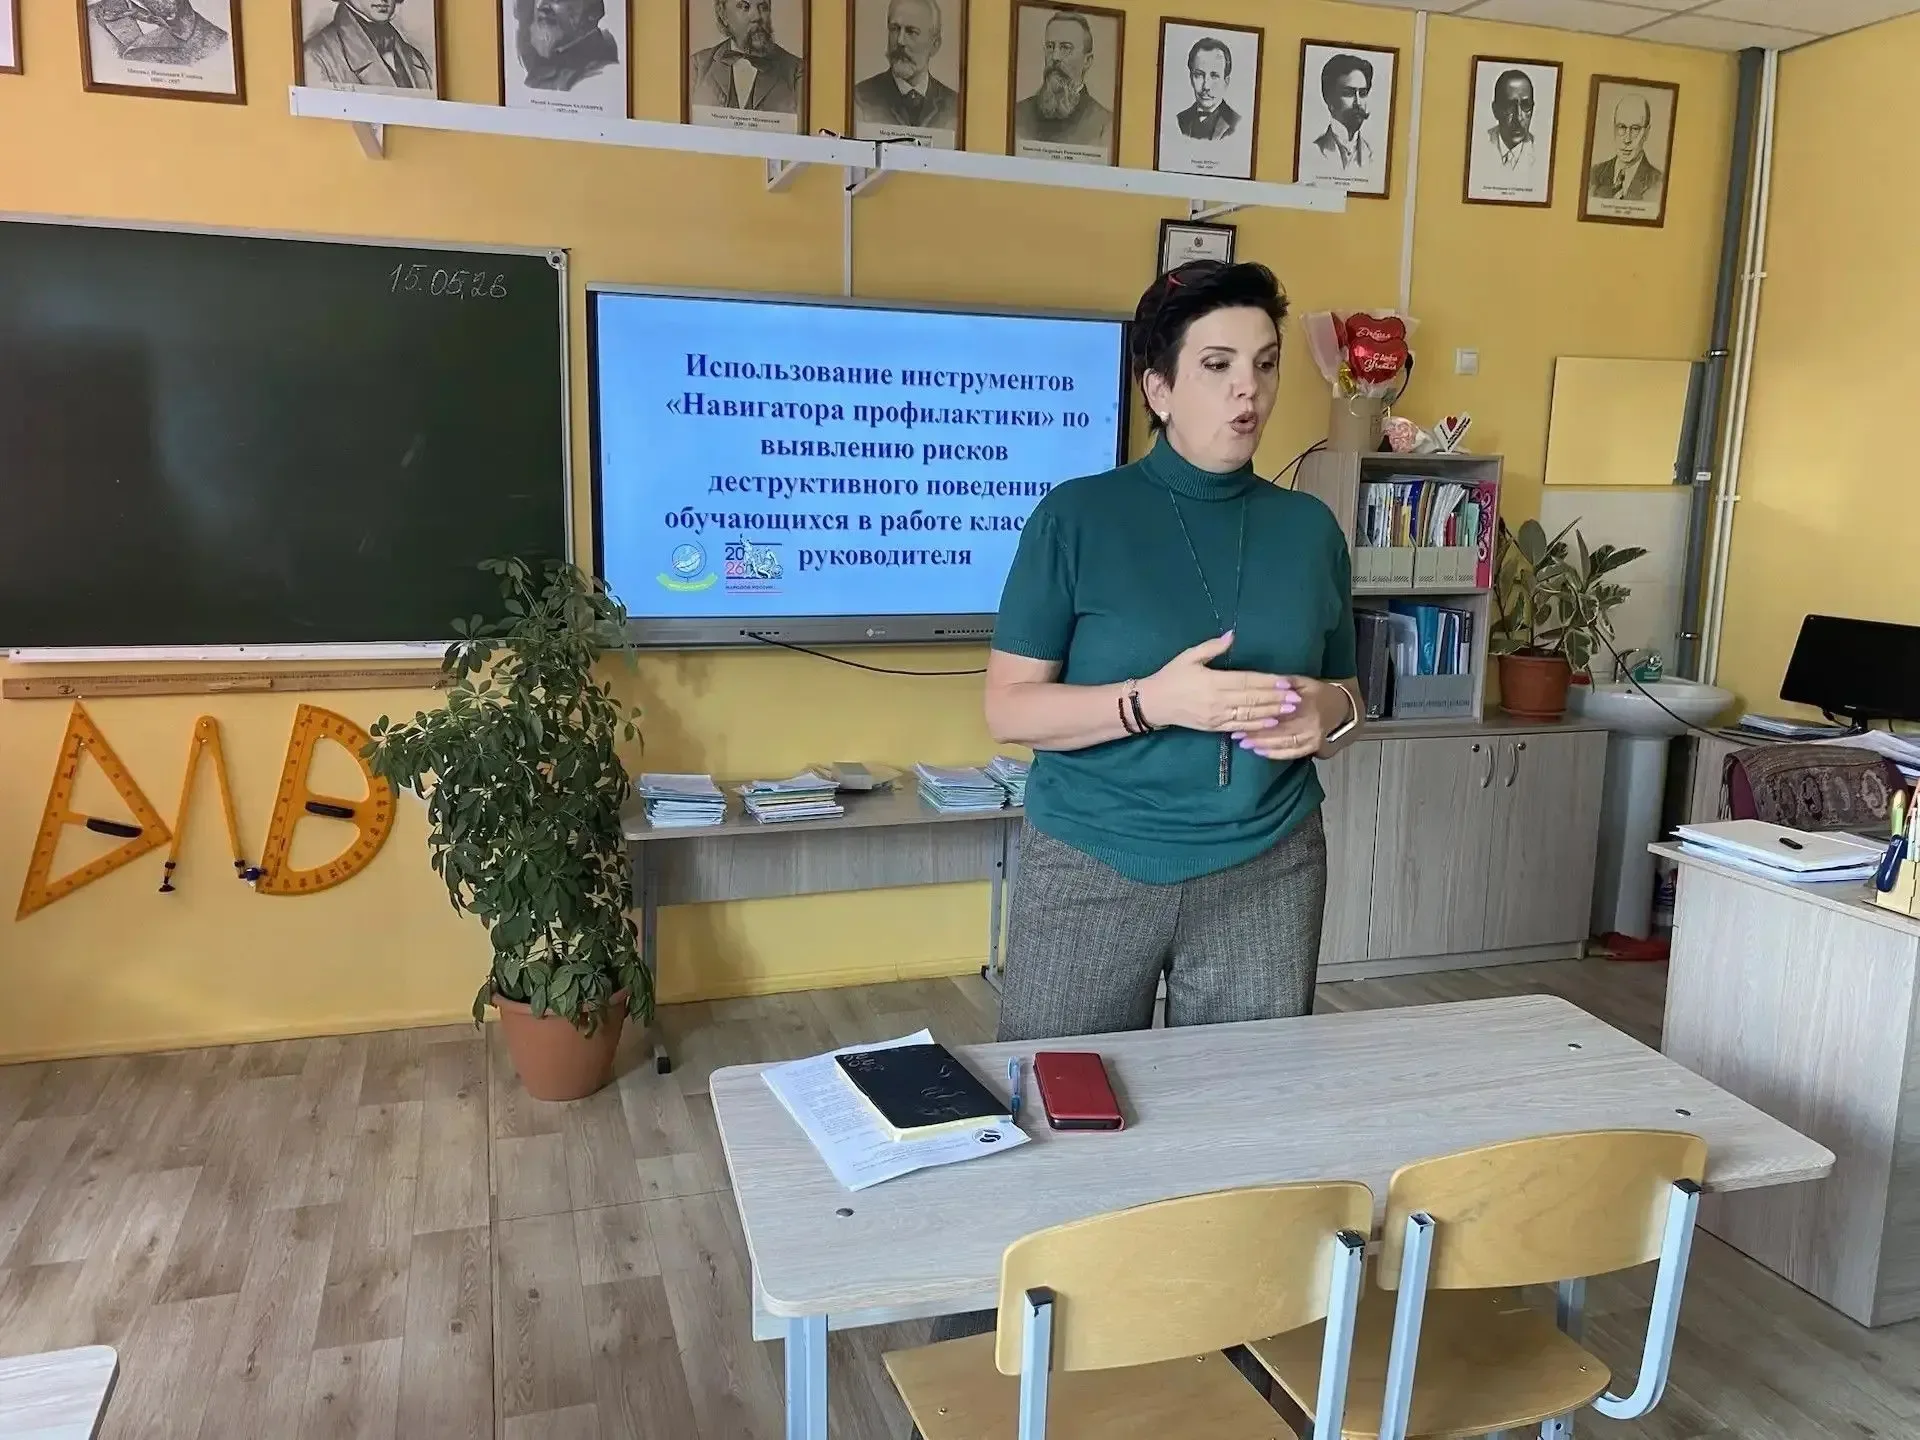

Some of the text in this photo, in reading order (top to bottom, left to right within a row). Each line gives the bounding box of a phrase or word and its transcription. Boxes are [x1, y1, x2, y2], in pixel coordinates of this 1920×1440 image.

[685, 352, 1075, 395] Использование инструментов
[665, 391, 1091, 429] «Навигатора профилактики» по
[760, 439, 1009, 467] выявлению рисков
[707, 474, 1053, 500] деструктивного поведения
[663, 506, 1026, 537] обучающихся в работе клас
[724, 546, 745, 561] 20
[798, 548, 973, 573] руководителя
[725, 561, 745, 576] 26
